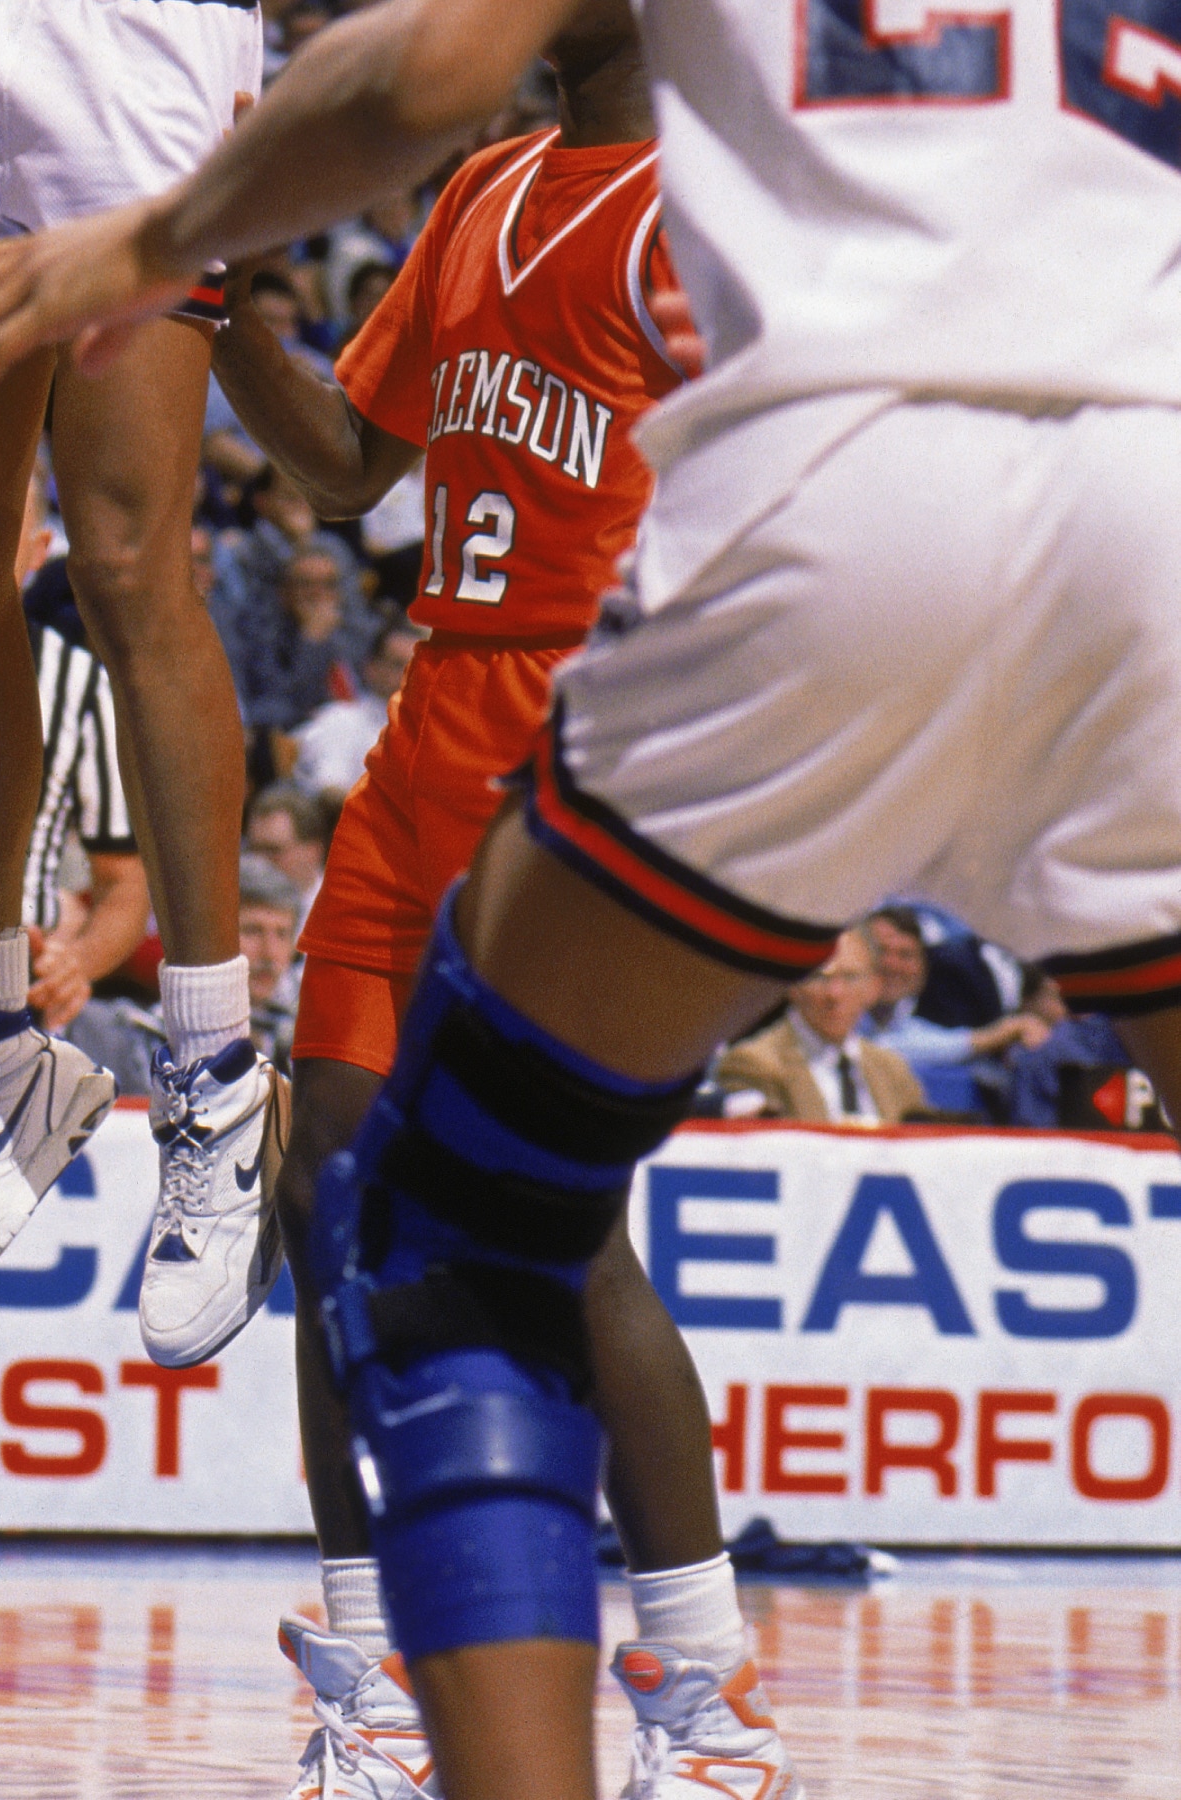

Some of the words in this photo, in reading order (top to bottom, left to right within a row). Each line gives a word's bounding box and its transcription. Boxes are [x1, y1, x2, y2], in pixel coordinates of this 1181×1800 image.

[425, 350, 612, 489] LEMSON
[424, 484, 515, 606] 12
[646, 1164, 1181, 1341] EAS
[708, 1382, 1171, 1503] HERFO
